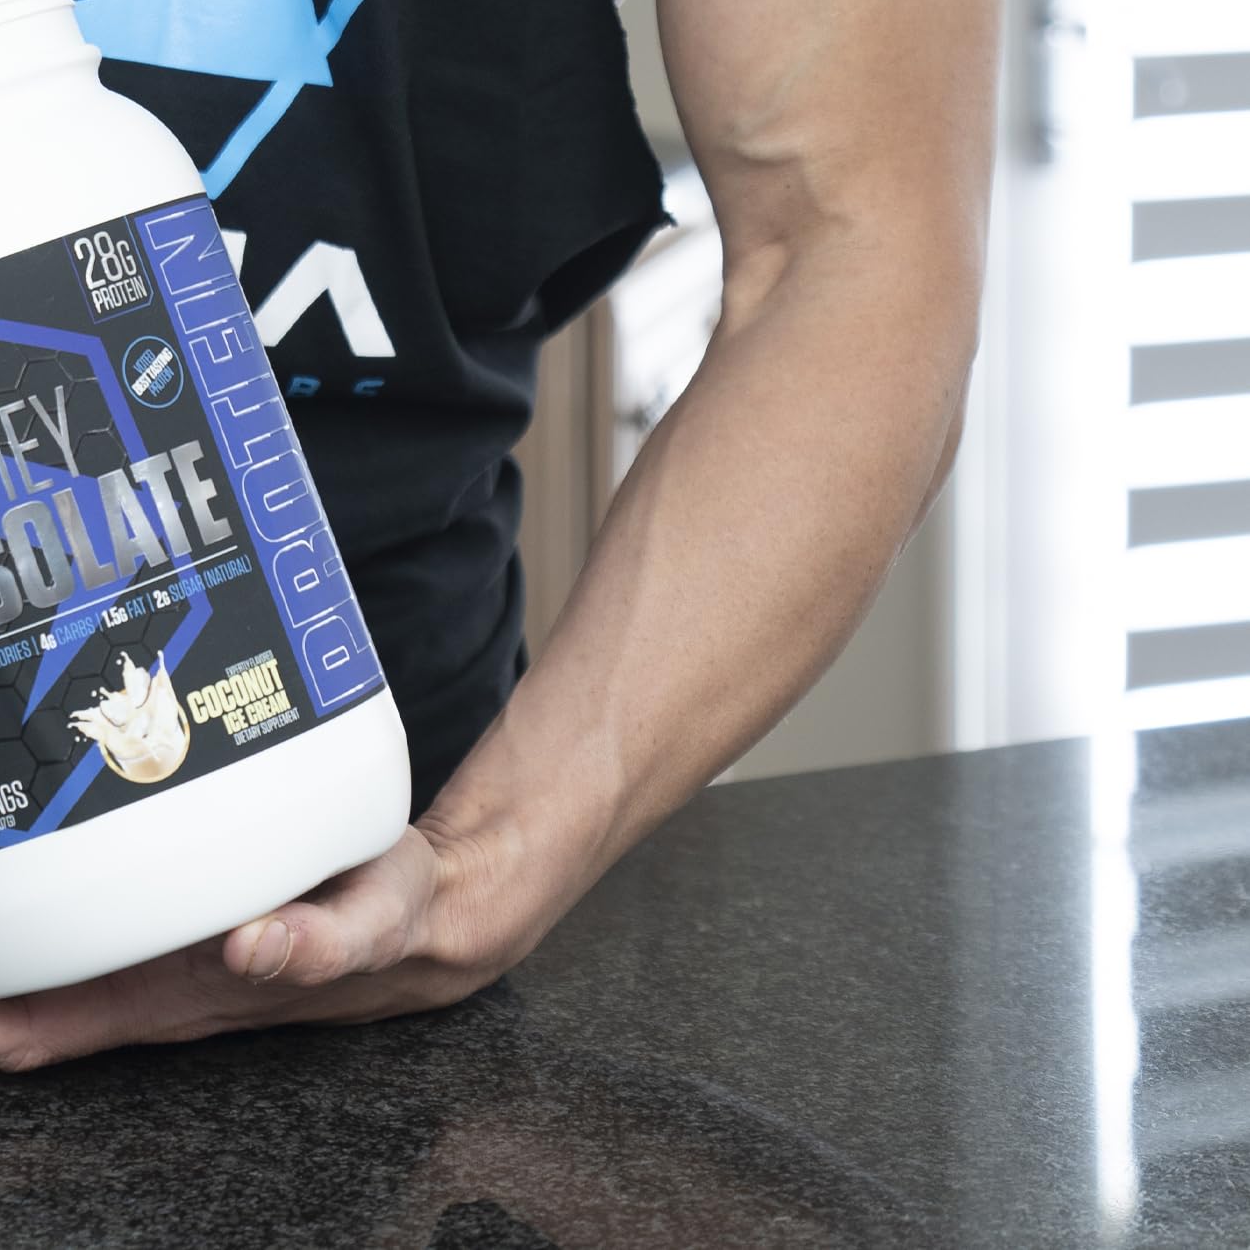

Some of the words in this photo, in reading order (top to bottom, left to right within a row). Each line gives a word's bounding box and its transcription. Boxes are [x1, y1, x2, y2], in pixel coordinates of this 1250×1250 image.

[73, 231, 137, 290] 28G
[91, 275, 147, 314] PROTEIN
[131, 370, 152, 396] BEST
[147, 347, 173, 380] TASTING
[145, 205, 383, 706] PROTEIN
[55, 616, 95, 645] CARBS
[125, 596, 147, 619] FAT
[168, 574, 206, 602] SUGAR
[203, 553, 253, 590] (NATURAL)
[186, 658, 284, 724] COCONUT
[222, 708, 249, 735] ICE
[245, 690, 291, 726] CREAM
[233, 724, 263, 746] DIETARY
[260, 707, 300, 735] SUPPLEMENT
